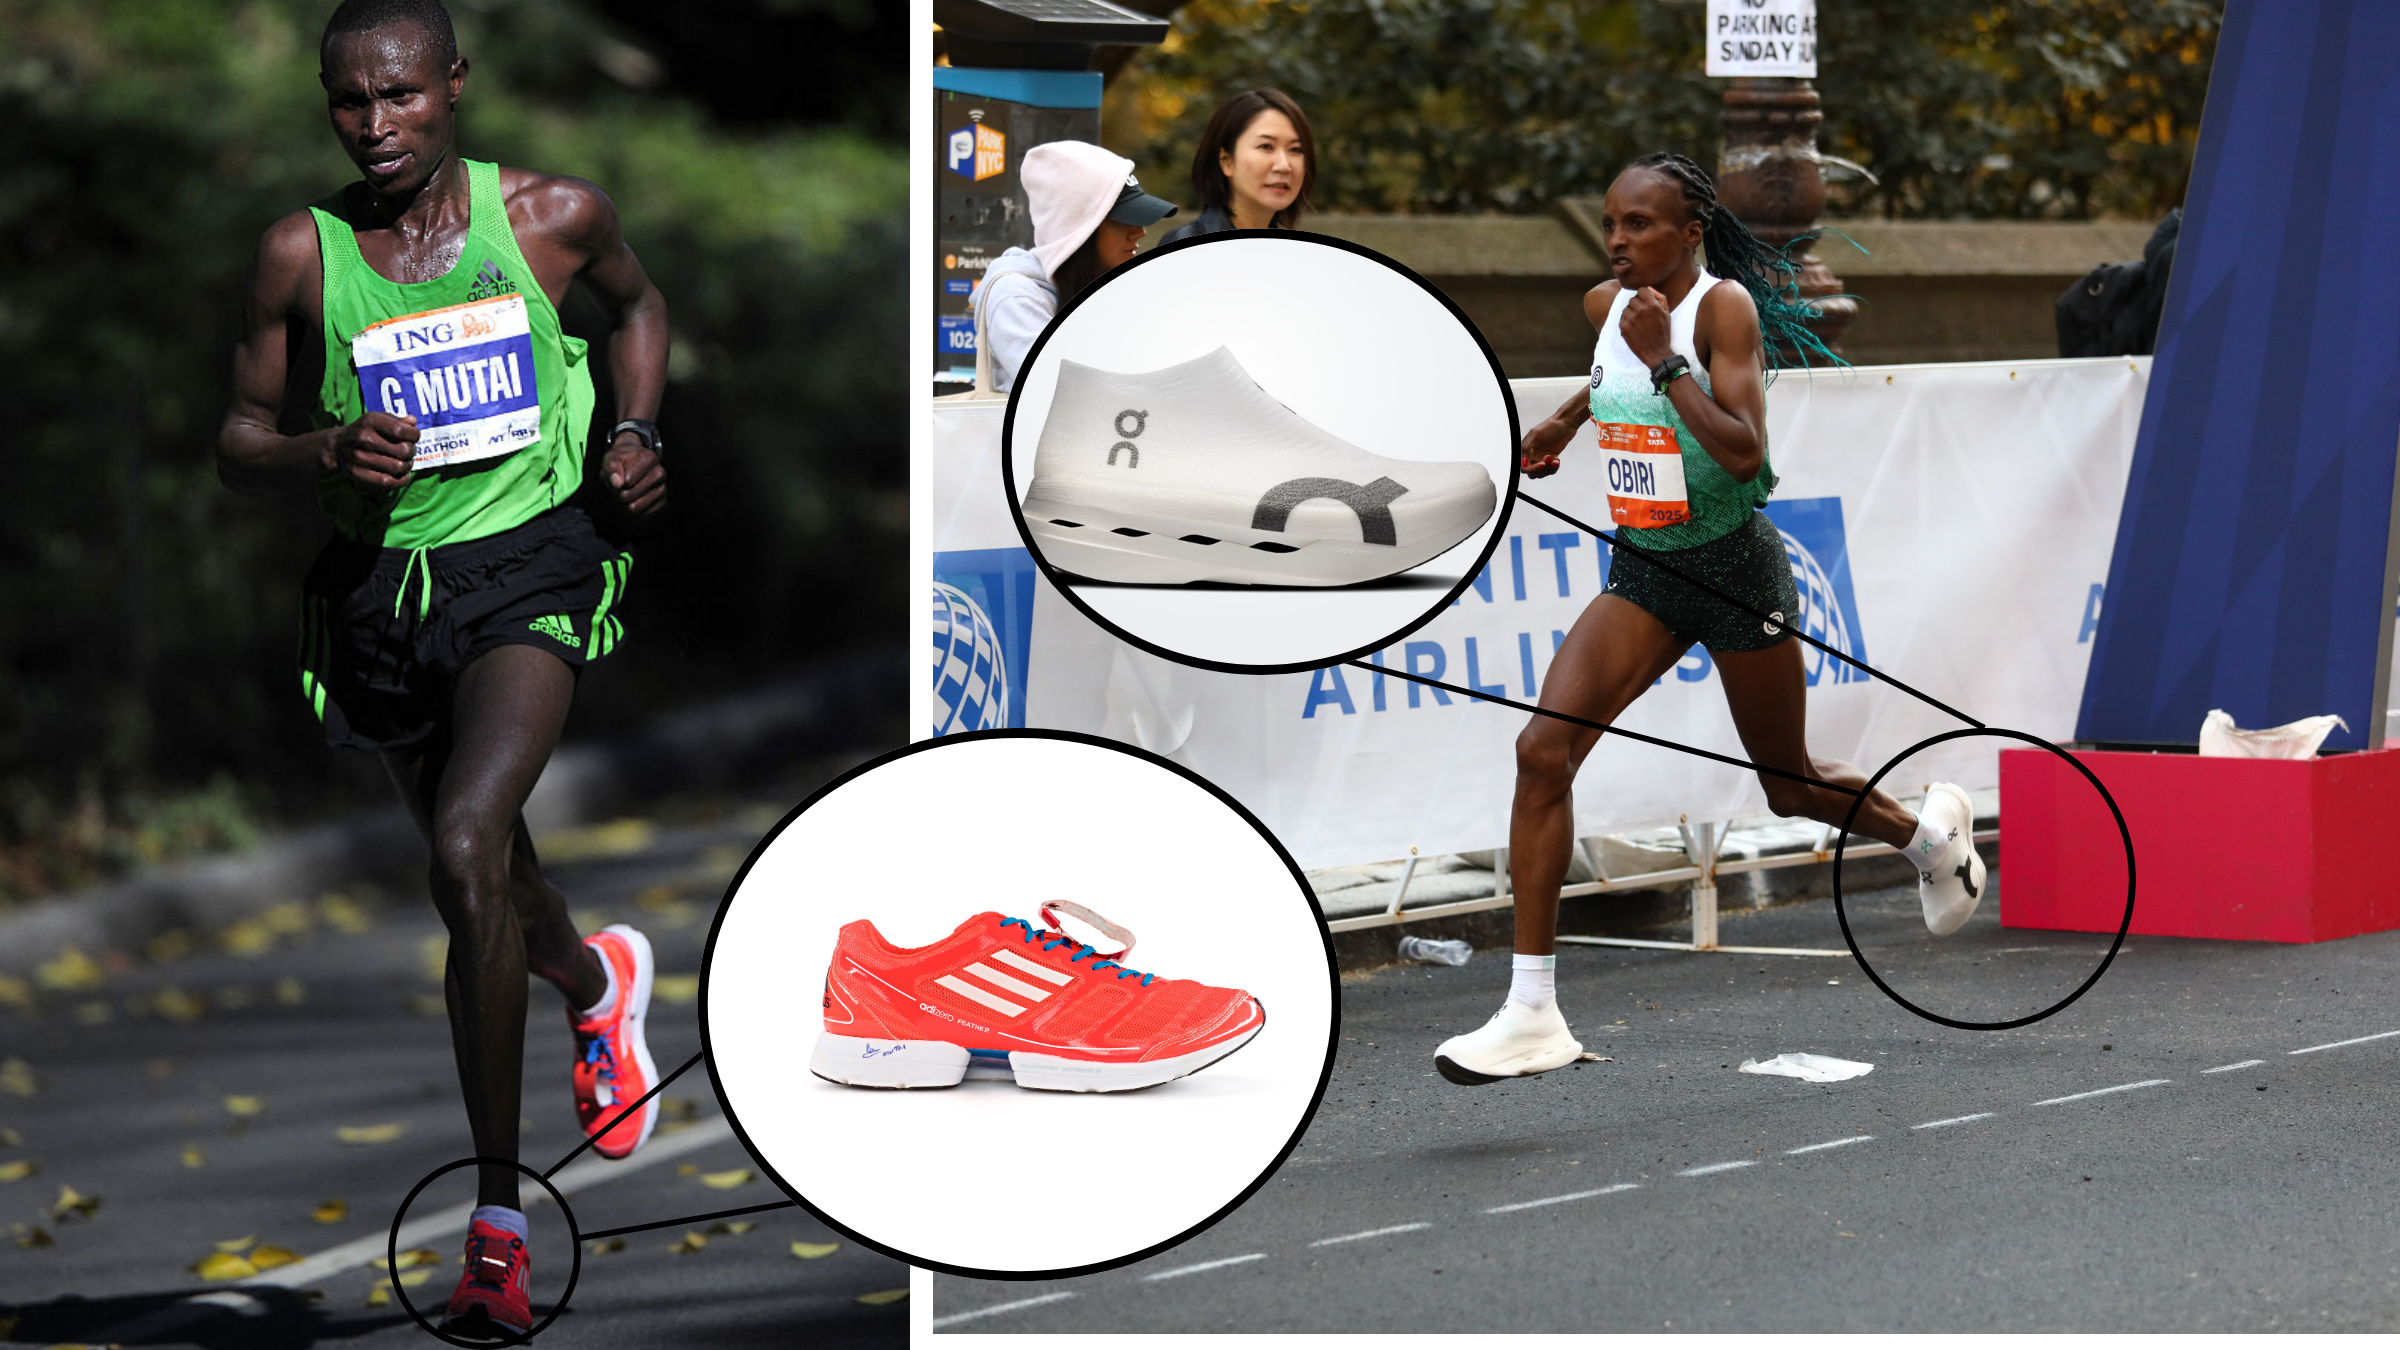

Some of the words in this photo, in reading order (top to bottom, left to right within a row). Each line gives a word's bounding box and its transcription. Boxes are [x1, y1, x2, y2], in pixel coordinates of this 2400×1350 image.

[1718, 14, 1796, 35] PARKING
[1721, 41, 1794, 61] SUNDAY
[978, 128, 1003, 151] PARK
[977, 151, 1003, 176] NYC
[467, 281, 516, 302] adidas
[393, 323, 454, 353] ING
[380, 377, 408, 418] G
[413, 352, 523, 415] MUTAI
[1608, 457, 1656, 496] OBIRI
[1650, 510, 1683, 521] 2025
[528, 622, 581, 648] adidas
[919, 1002, 954, 1022] adizero
[957, 1018, 990, 1034] FEATHER
